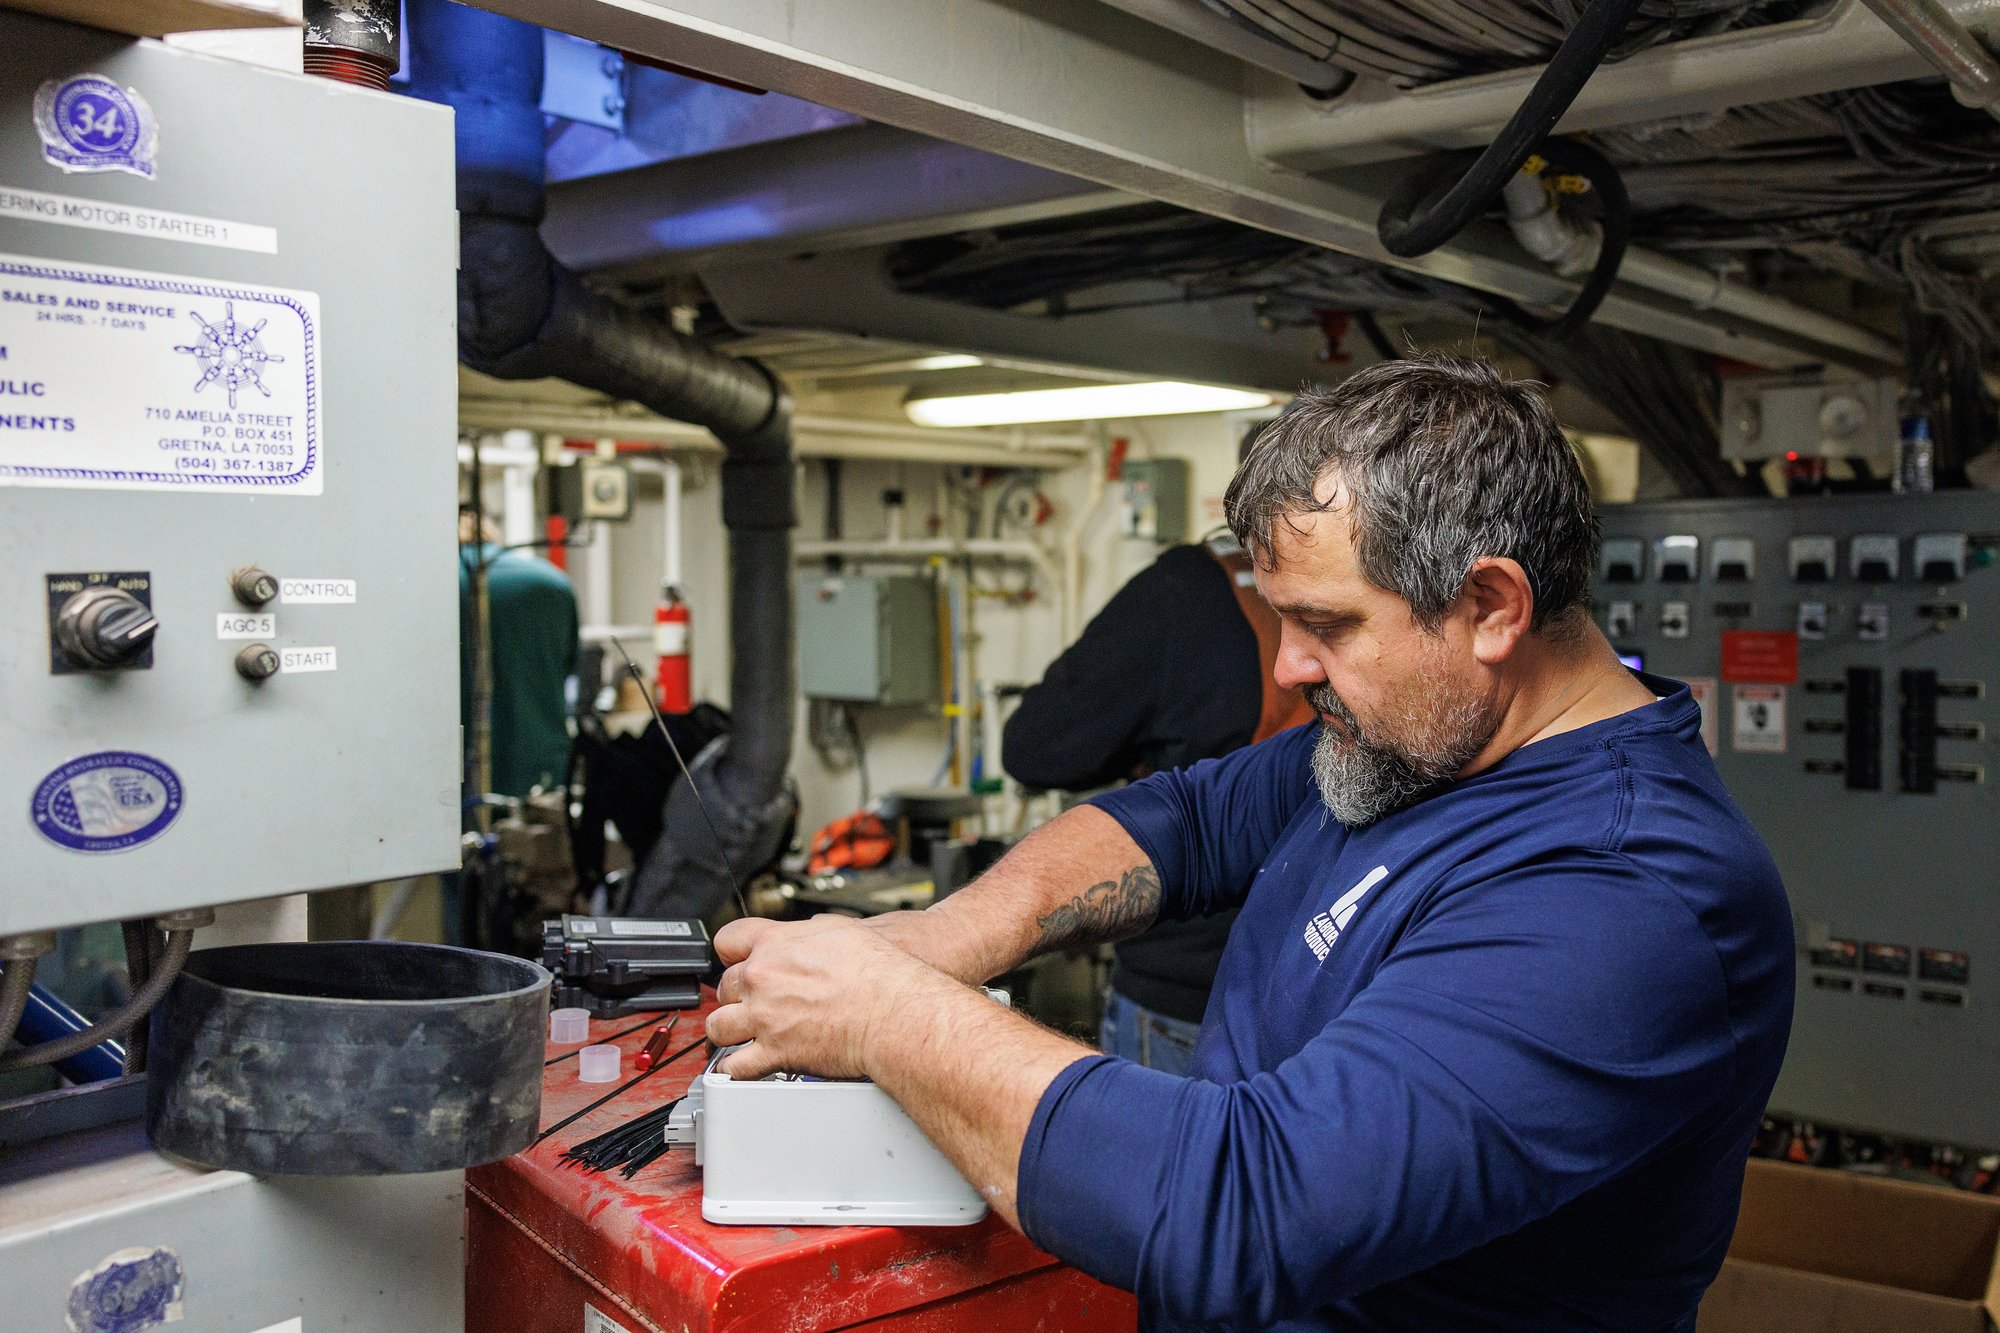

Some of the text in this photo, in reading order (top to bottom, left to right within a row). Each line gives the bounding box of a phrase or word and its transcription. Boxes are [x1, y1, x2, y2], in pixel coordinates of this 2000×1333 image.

[64, 203, 130, 225] MOTOR
[137, 214, 216, 238] STARTER
[222, 227, 228, 240] 1
[2, 290, 175, 318] SALES AND SERVICE
[37, 311, 51, 322] 24
[101, 317, 107, 327] 7
[111, 318, 147, 331] DAYS
[145, 407, 293, 427] 710 AMELIA STREET
[203, 426, 293, 441] P.O. BOX 451
[158, 438, 294, 456] GRETNA, LA 70053
[175, 457, 294, 472] (504) 367-1387
[118, 578, 149, 591] AUTO
[282, 583, 353, 597] CONTROL
[222, 619, 270, 633] AGC 5
[284, 652, 331, 668] START
[1303, 920, 1331, 963] PRODUC
